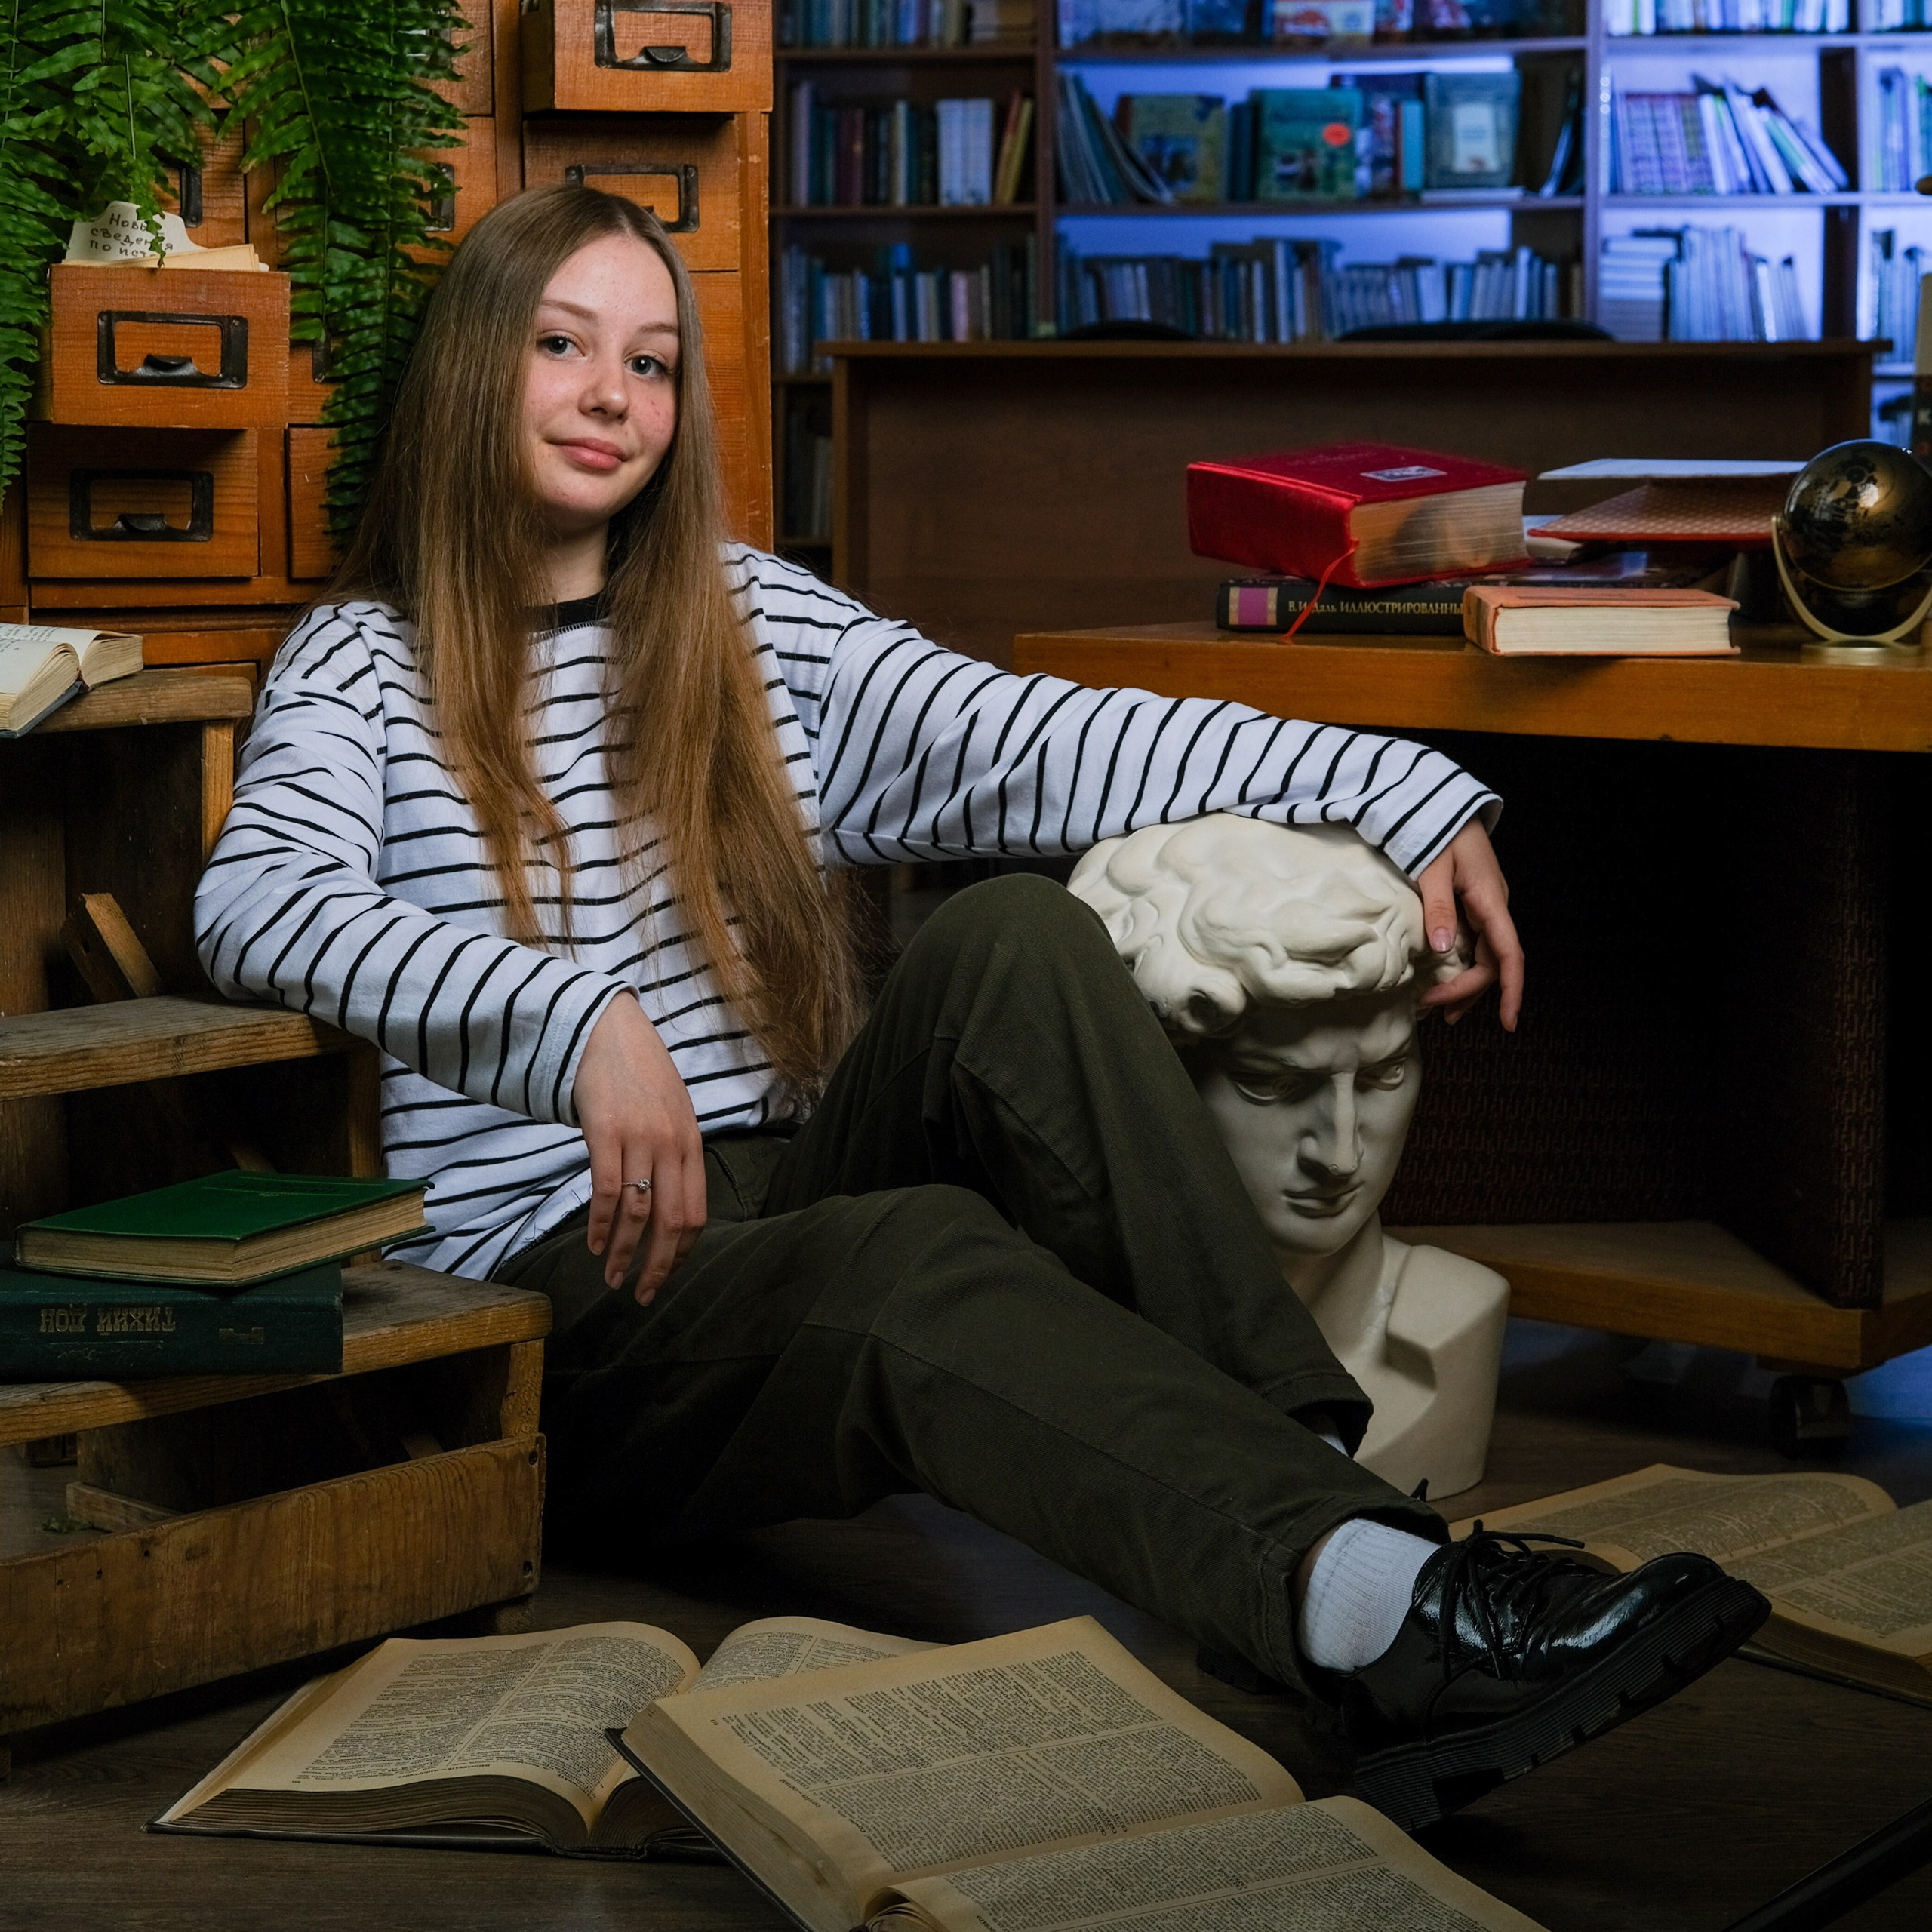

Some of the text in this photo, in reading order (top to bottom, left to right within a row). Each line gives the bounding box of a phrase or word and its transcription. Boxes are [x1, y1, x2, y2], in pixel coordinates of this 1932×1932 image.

[90, 240, 156, 258] по ист
[91, 227, 174, 251] сведеня
[1340, 601, 1464, 614] ИЛЛЮСТРИРОВАННЫ
[39, 1303, 176, 1337] ТИХИЙ ДОН
